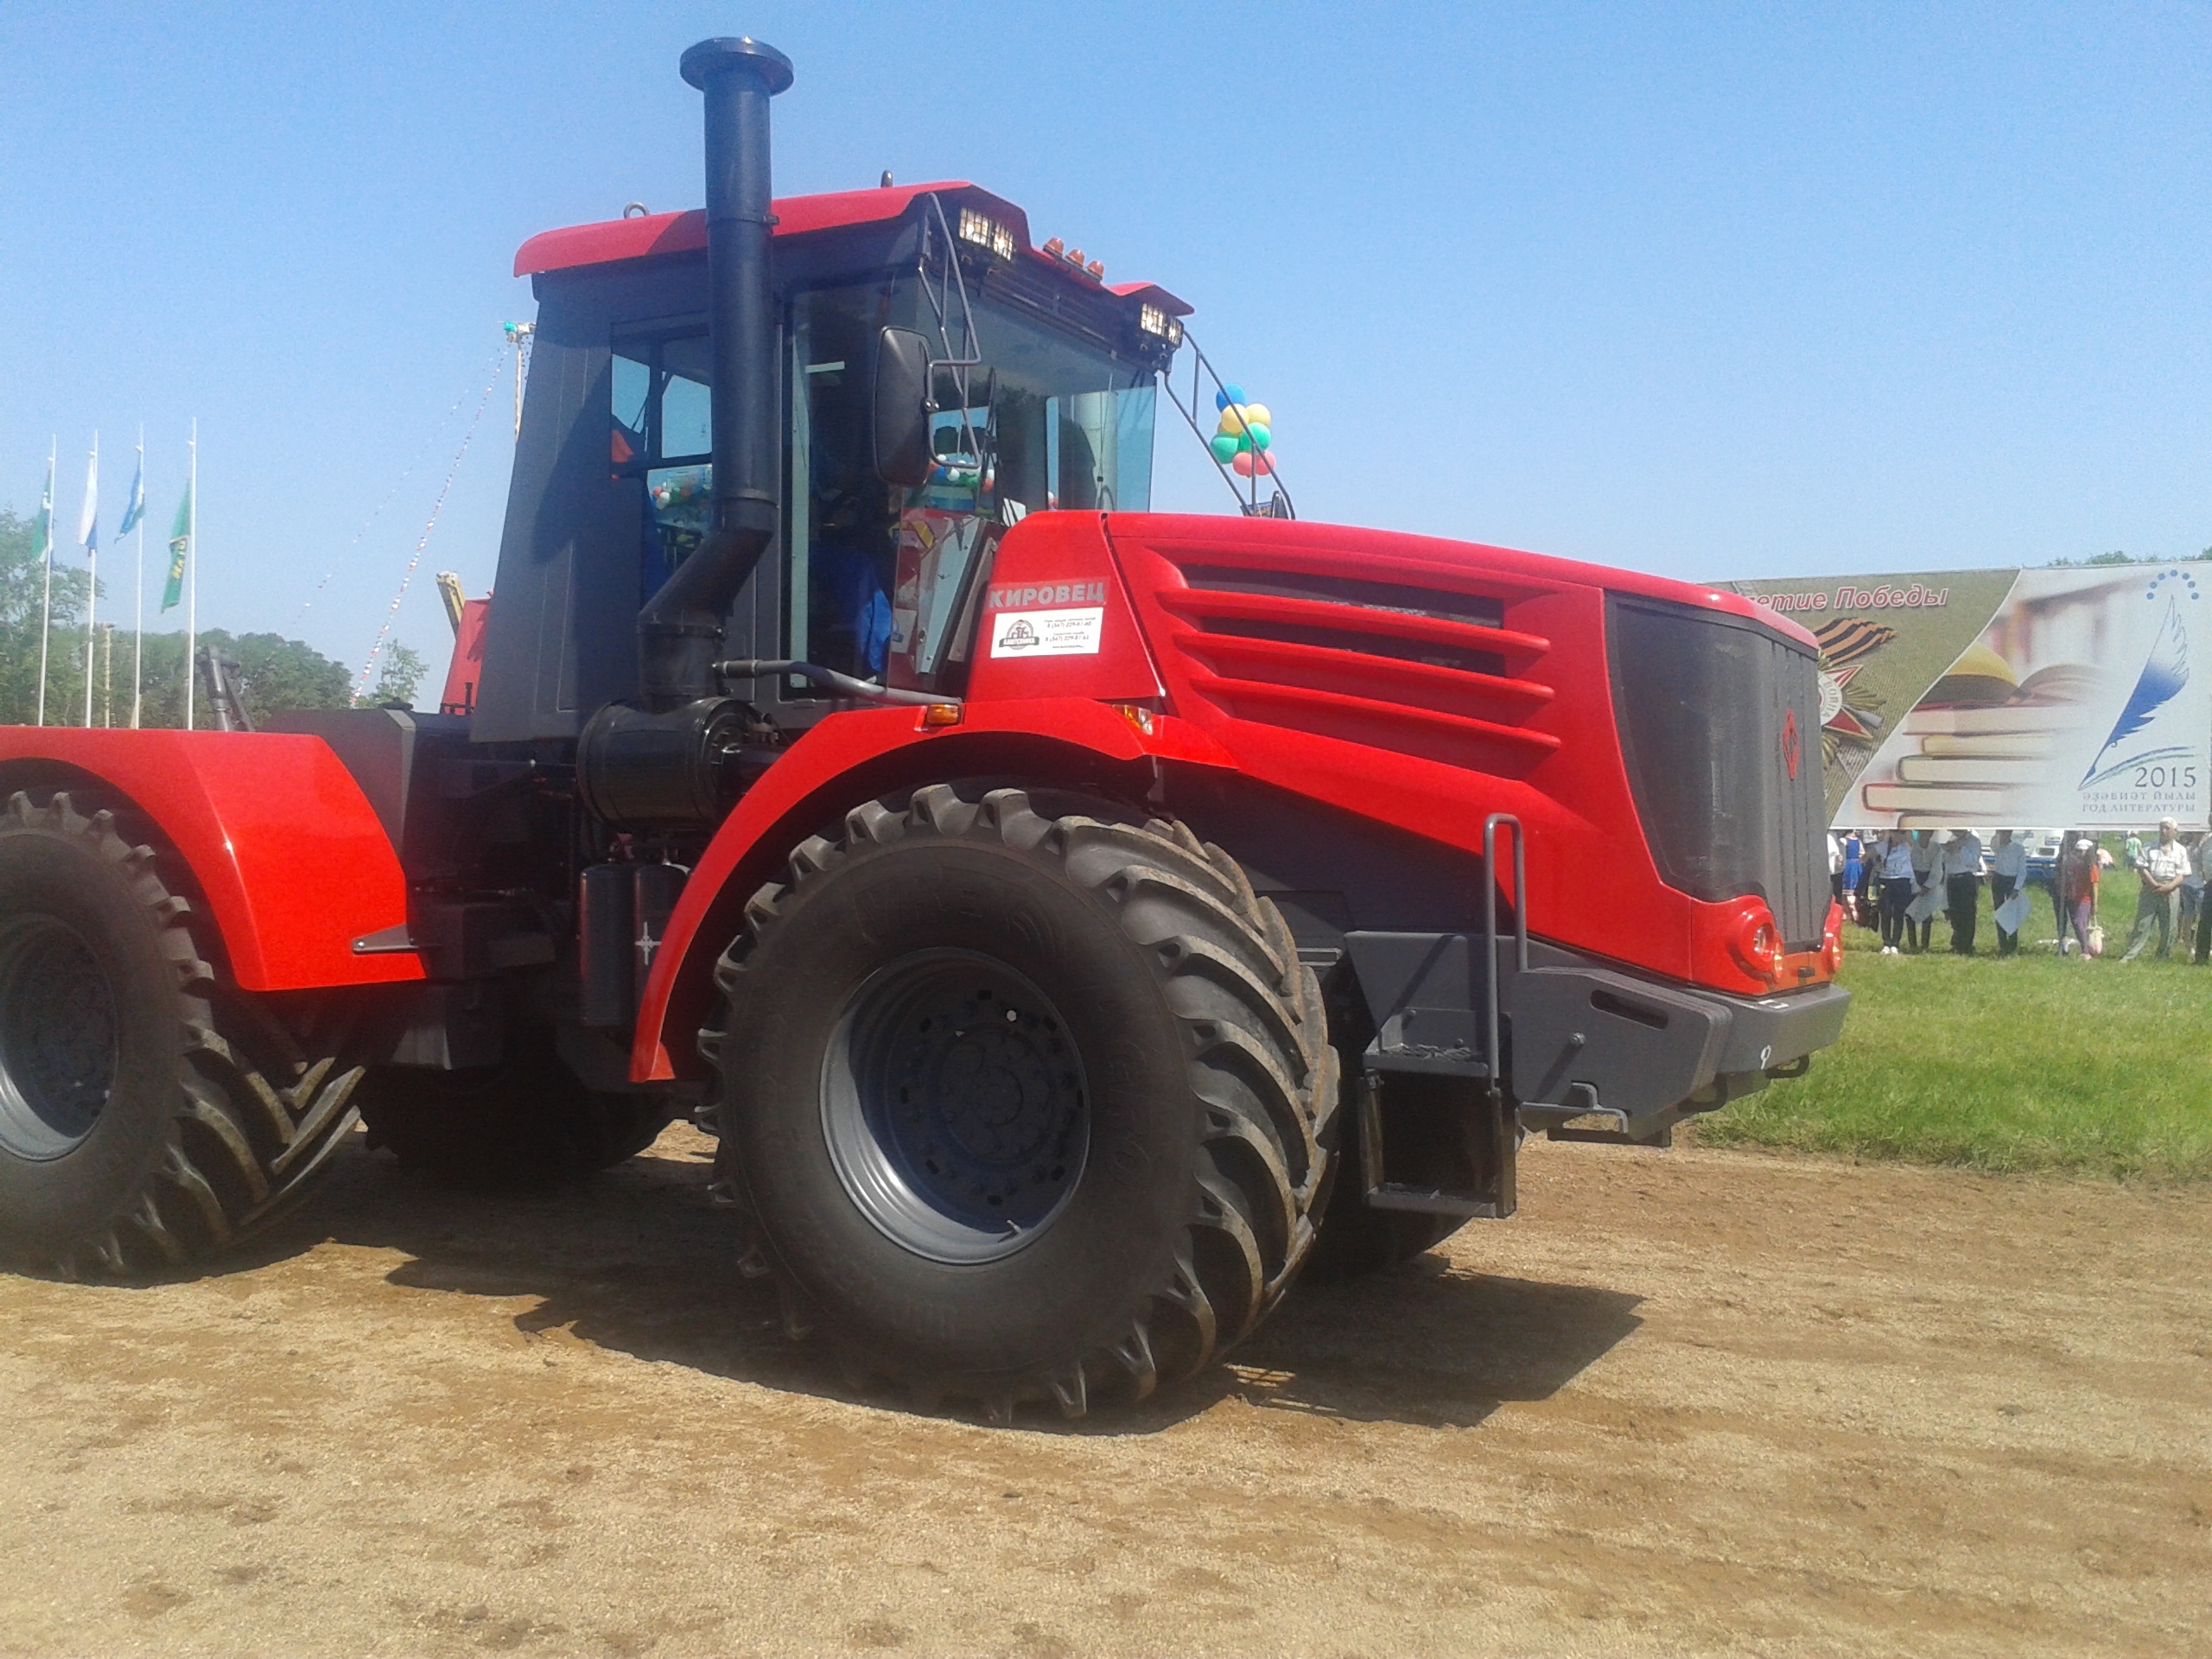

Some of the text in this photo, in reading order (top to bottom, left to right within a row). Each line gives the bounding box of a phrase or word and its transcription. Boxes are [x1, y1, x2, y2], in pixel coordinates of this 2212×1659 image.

[988, 582, 1104, 607] КИРОВЕЦ
[1747, 584, 1949, 612] етие Победы
[2134, 766, 2196, 788] 2015
[2153, 790, 2196, 800] ЙЫЛЫ
[2082, 804, 2195, 813] ГОД ЛИТЕРАТУРЫ
